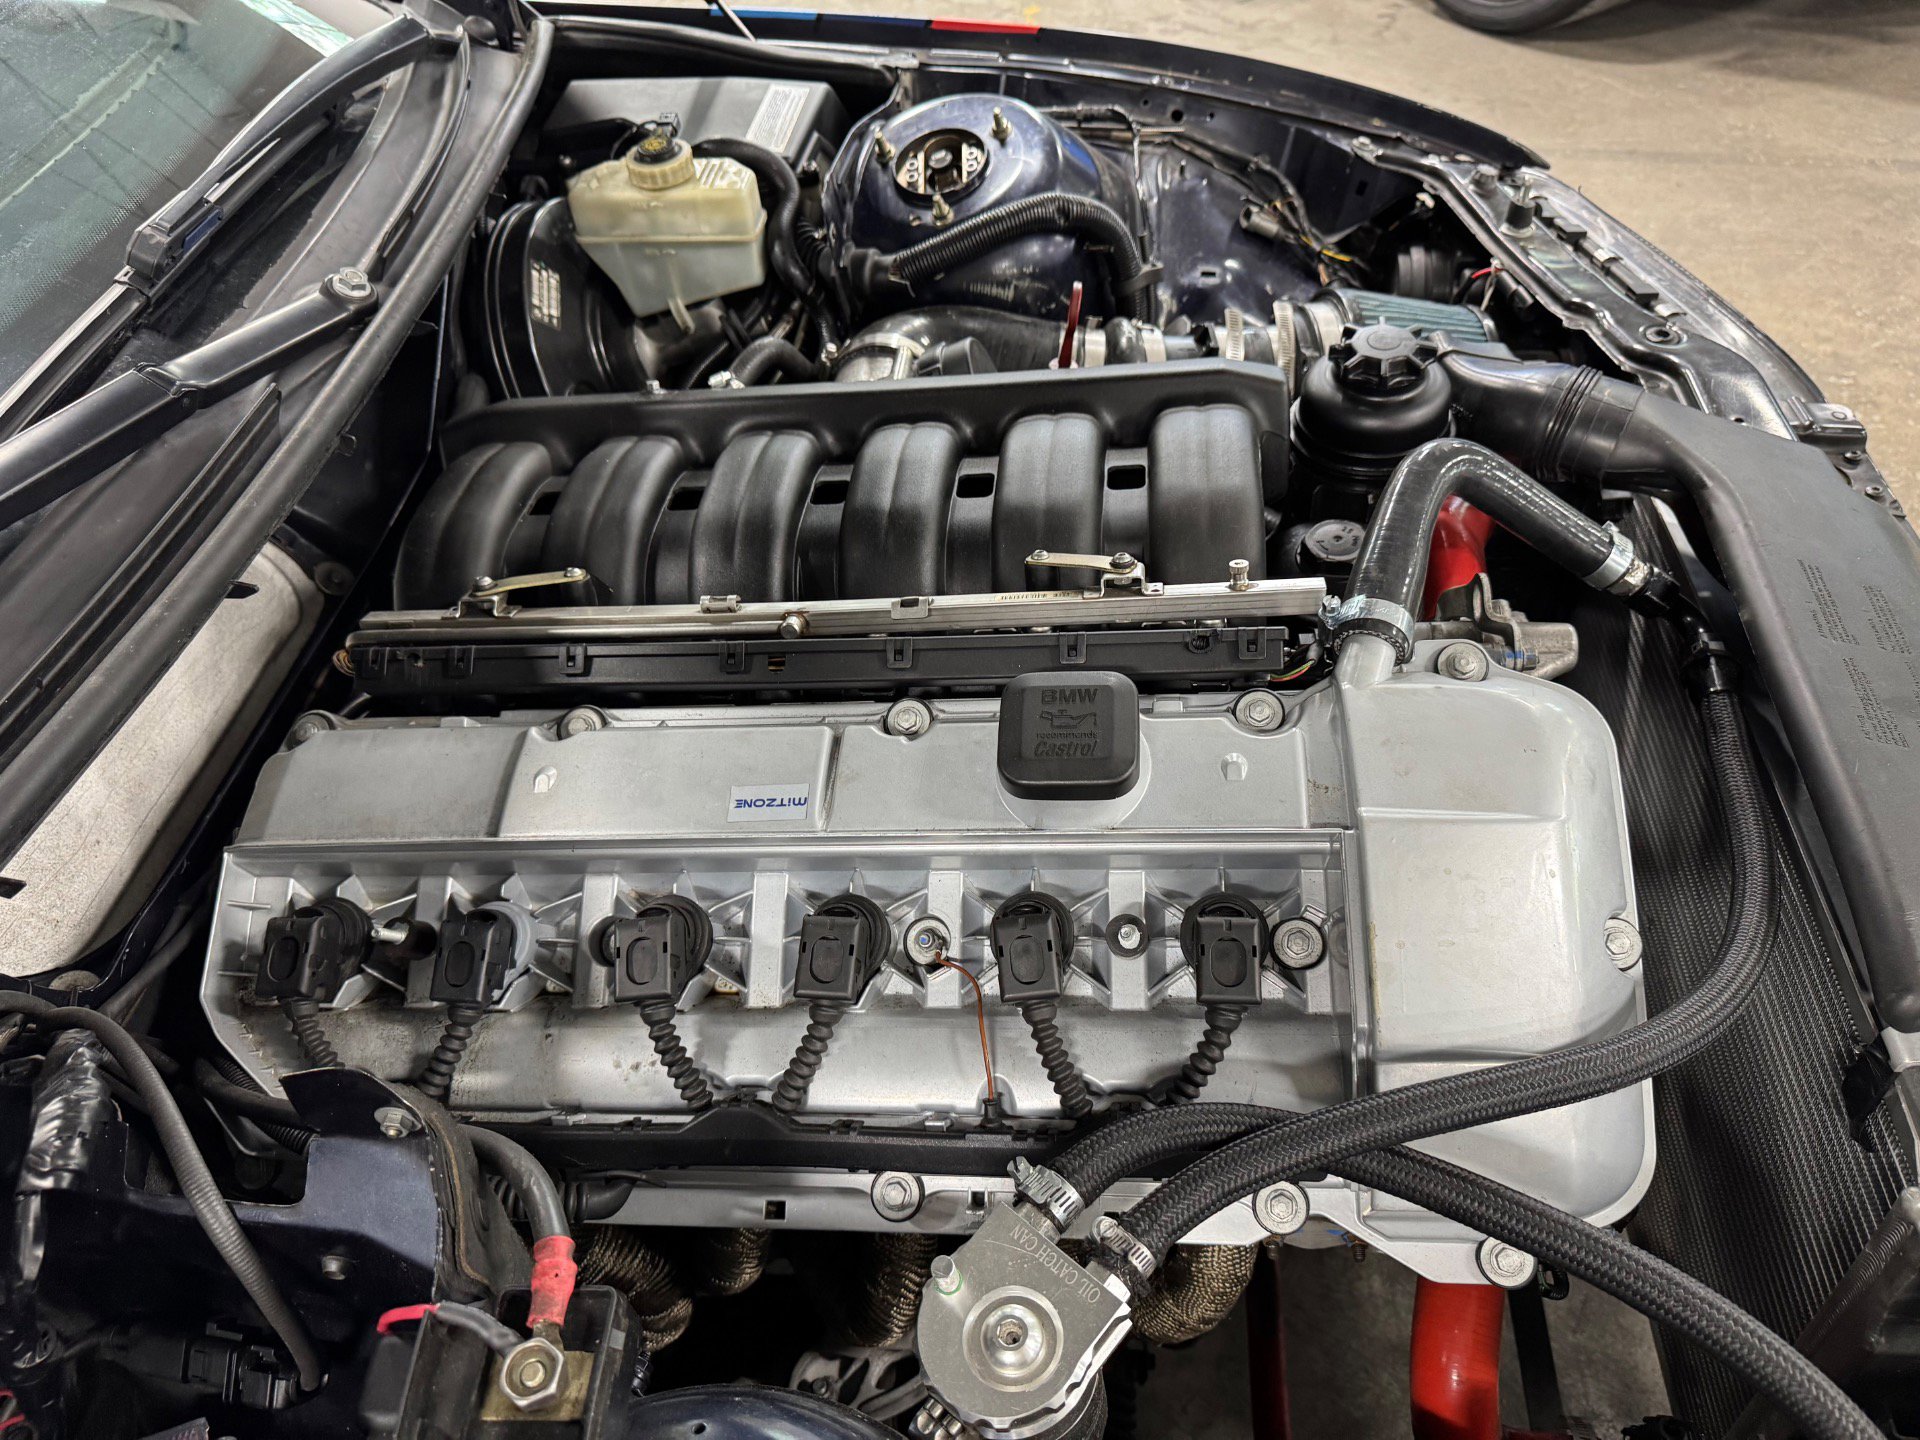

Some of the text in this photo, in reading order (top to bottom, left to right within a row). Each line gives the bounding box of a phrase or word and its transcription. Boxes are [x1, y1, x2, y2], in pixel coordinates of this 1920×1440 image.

[1041, 688, 1098, 705] BMW
[1036, 730, 1098, 740] recommends
[1034, 740, 1097, 758] Castrol
[1009, 1223, 1101, 1304] OIL CATCH CAN
